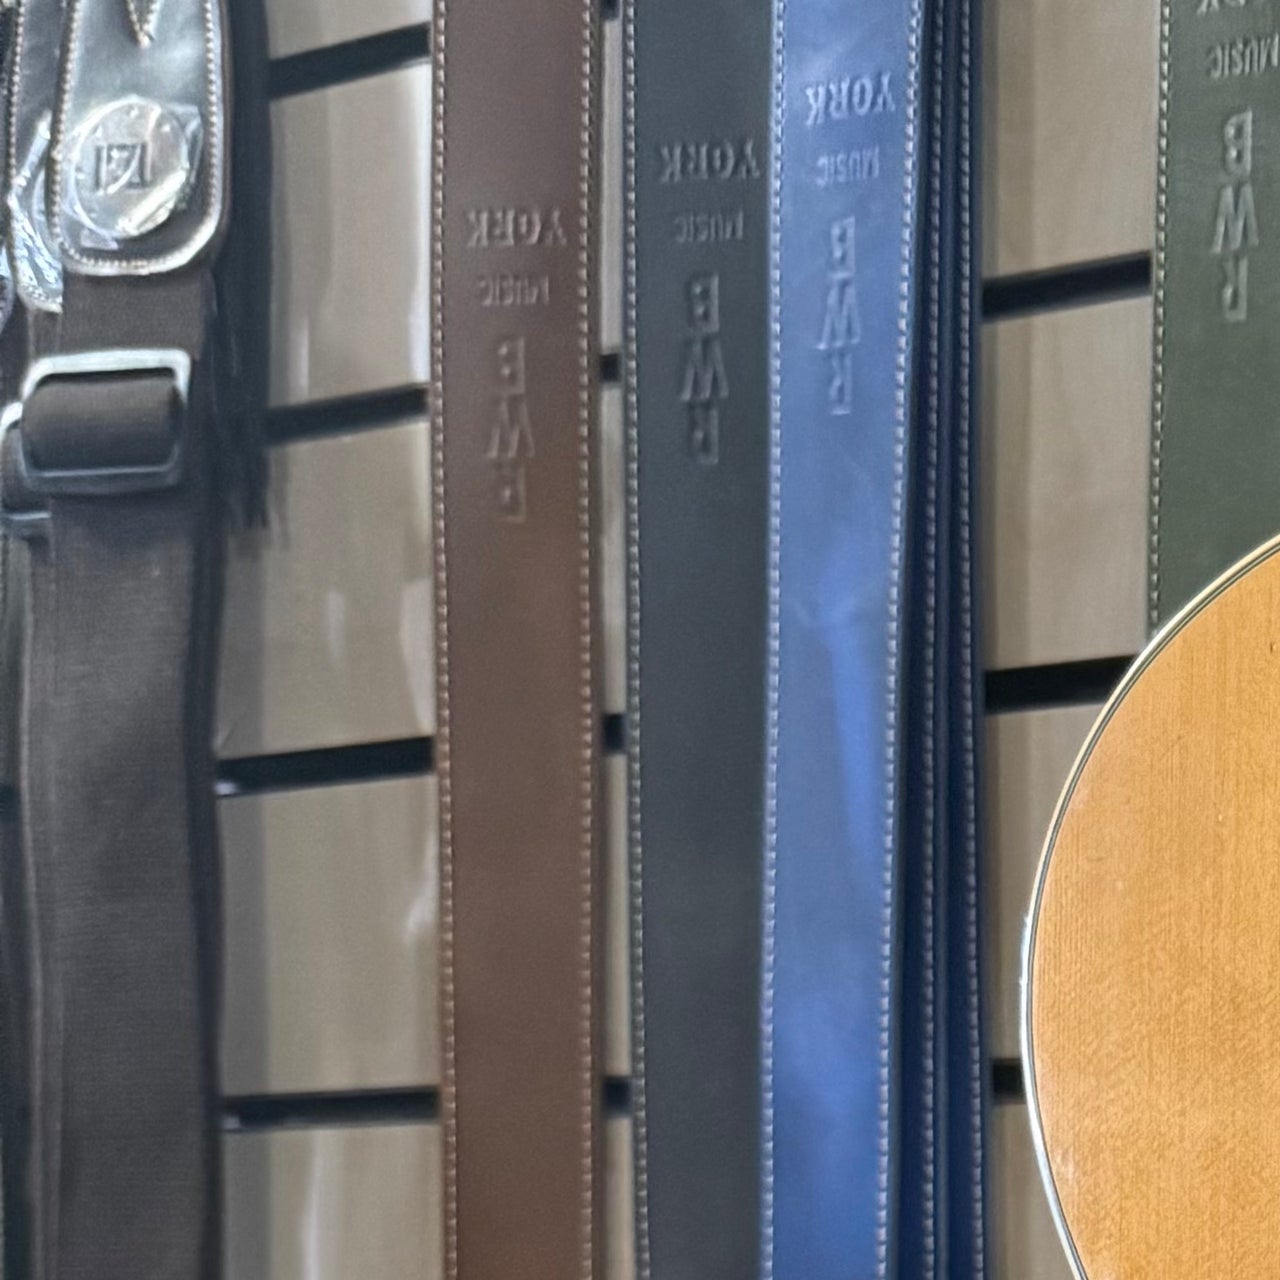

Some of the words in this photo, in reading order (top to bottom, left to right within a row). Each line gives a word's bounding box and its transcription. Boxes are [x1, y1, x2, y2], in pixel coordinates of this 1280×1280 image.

[1209, 32, 1279, 79] MUSIC
[805, 70, 897, 127] YORK
[660, 138, 761, 184] YORK
[813, 145, 880, 187] MUSIC
[466, 207, 567, 248] YORK
[674, 210, 744, 243] MUSIC
